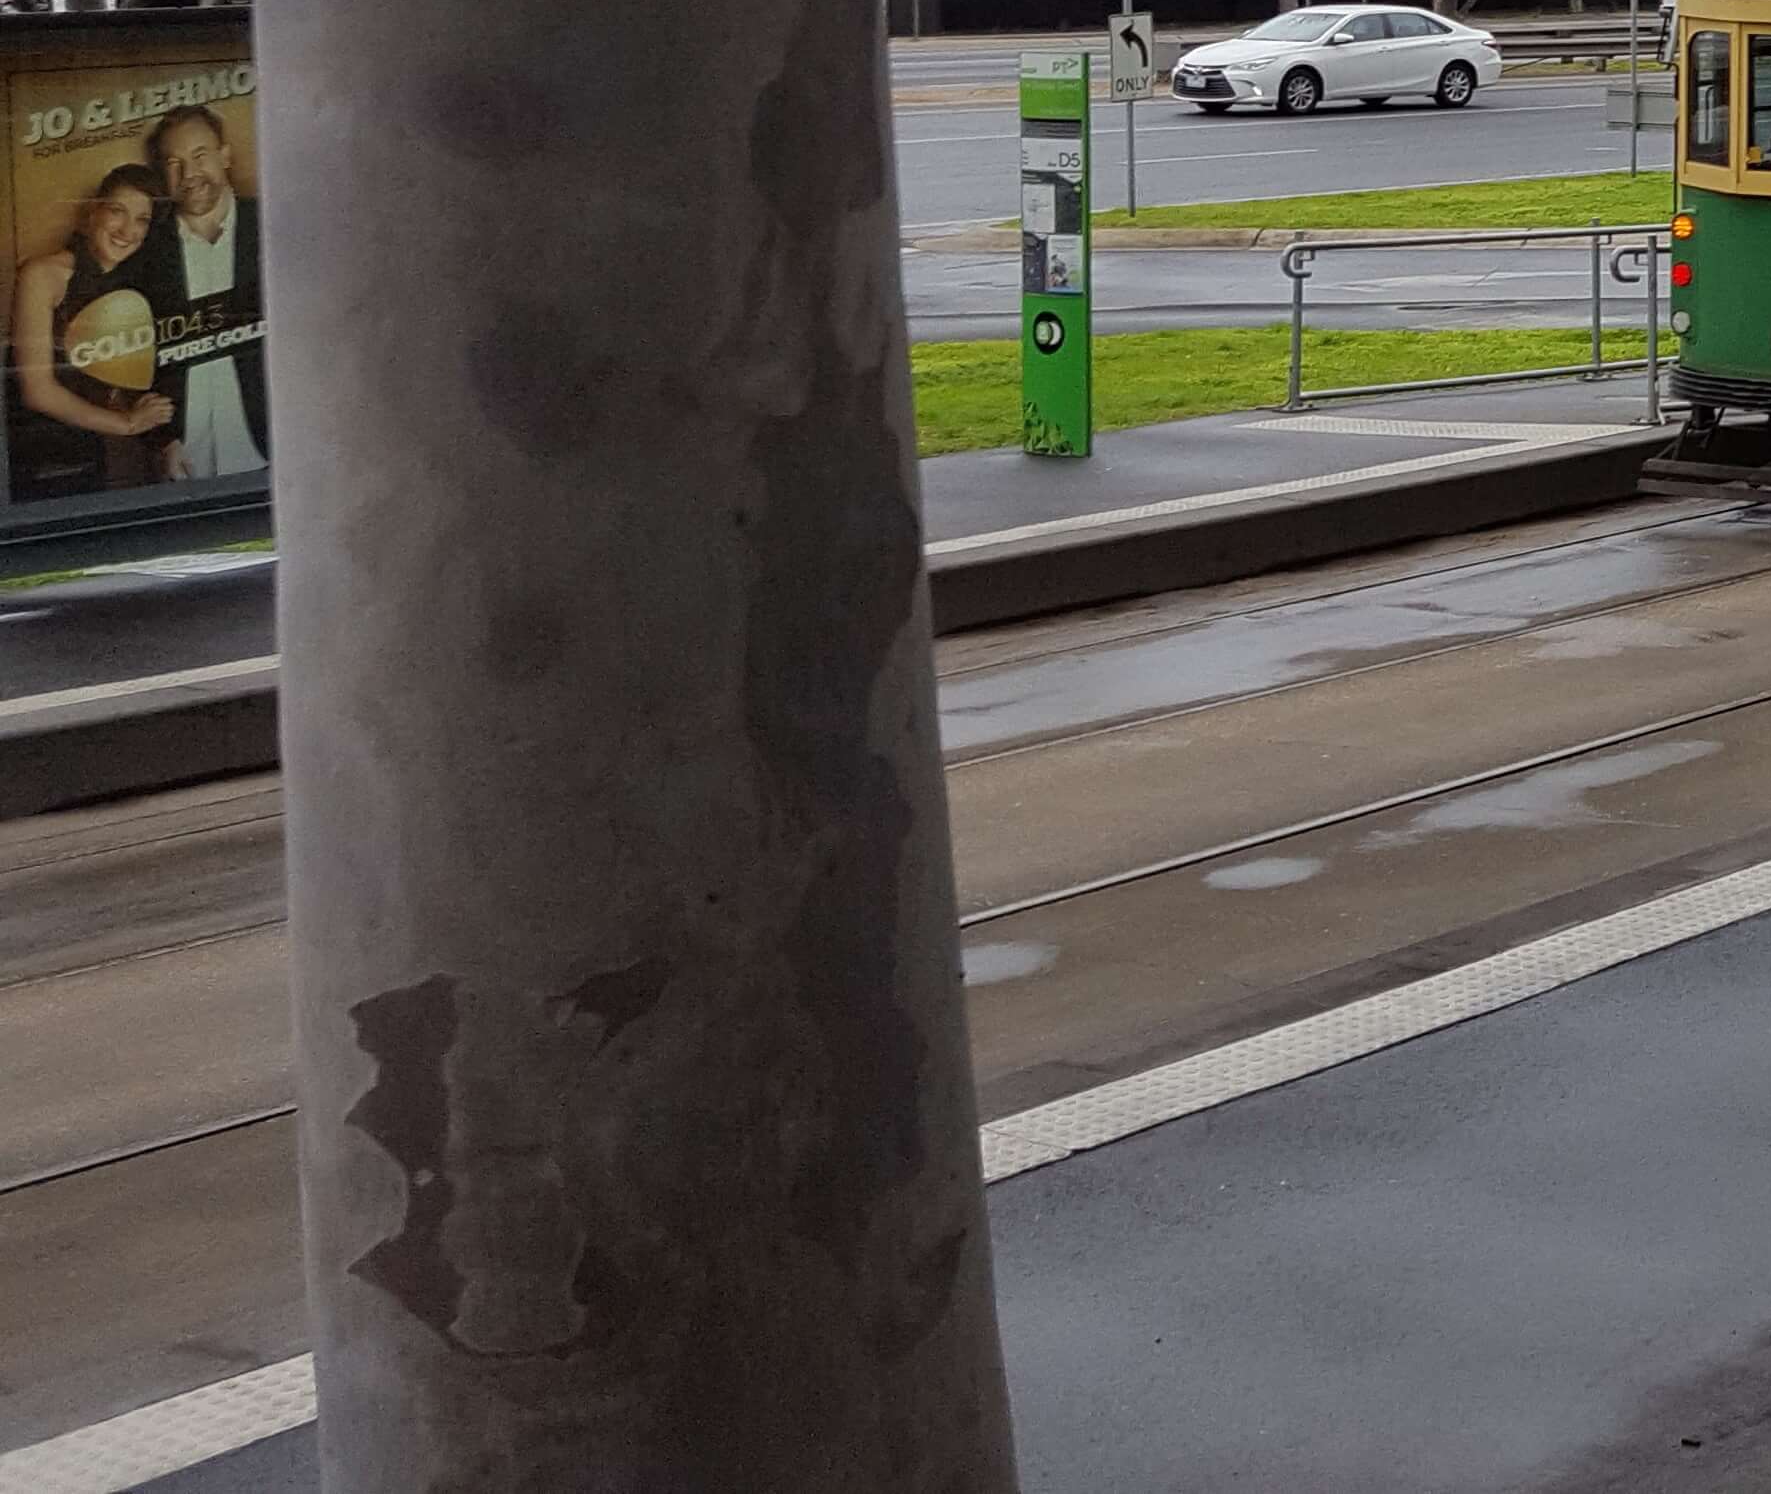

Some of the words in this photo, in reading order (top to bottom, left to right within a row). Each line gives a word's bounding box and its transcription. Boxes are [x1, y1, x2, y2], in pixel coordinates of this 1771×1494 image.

[23, 105, 75, 146] JO
[118, 63, 257, 124] LEHMO
[1115, 76, 1150, 93] ONLY
[70, 325, 155, 368] GOLD
[157, 335, 217, 367] PURE
[216, 320, 272, 349] GOLD
